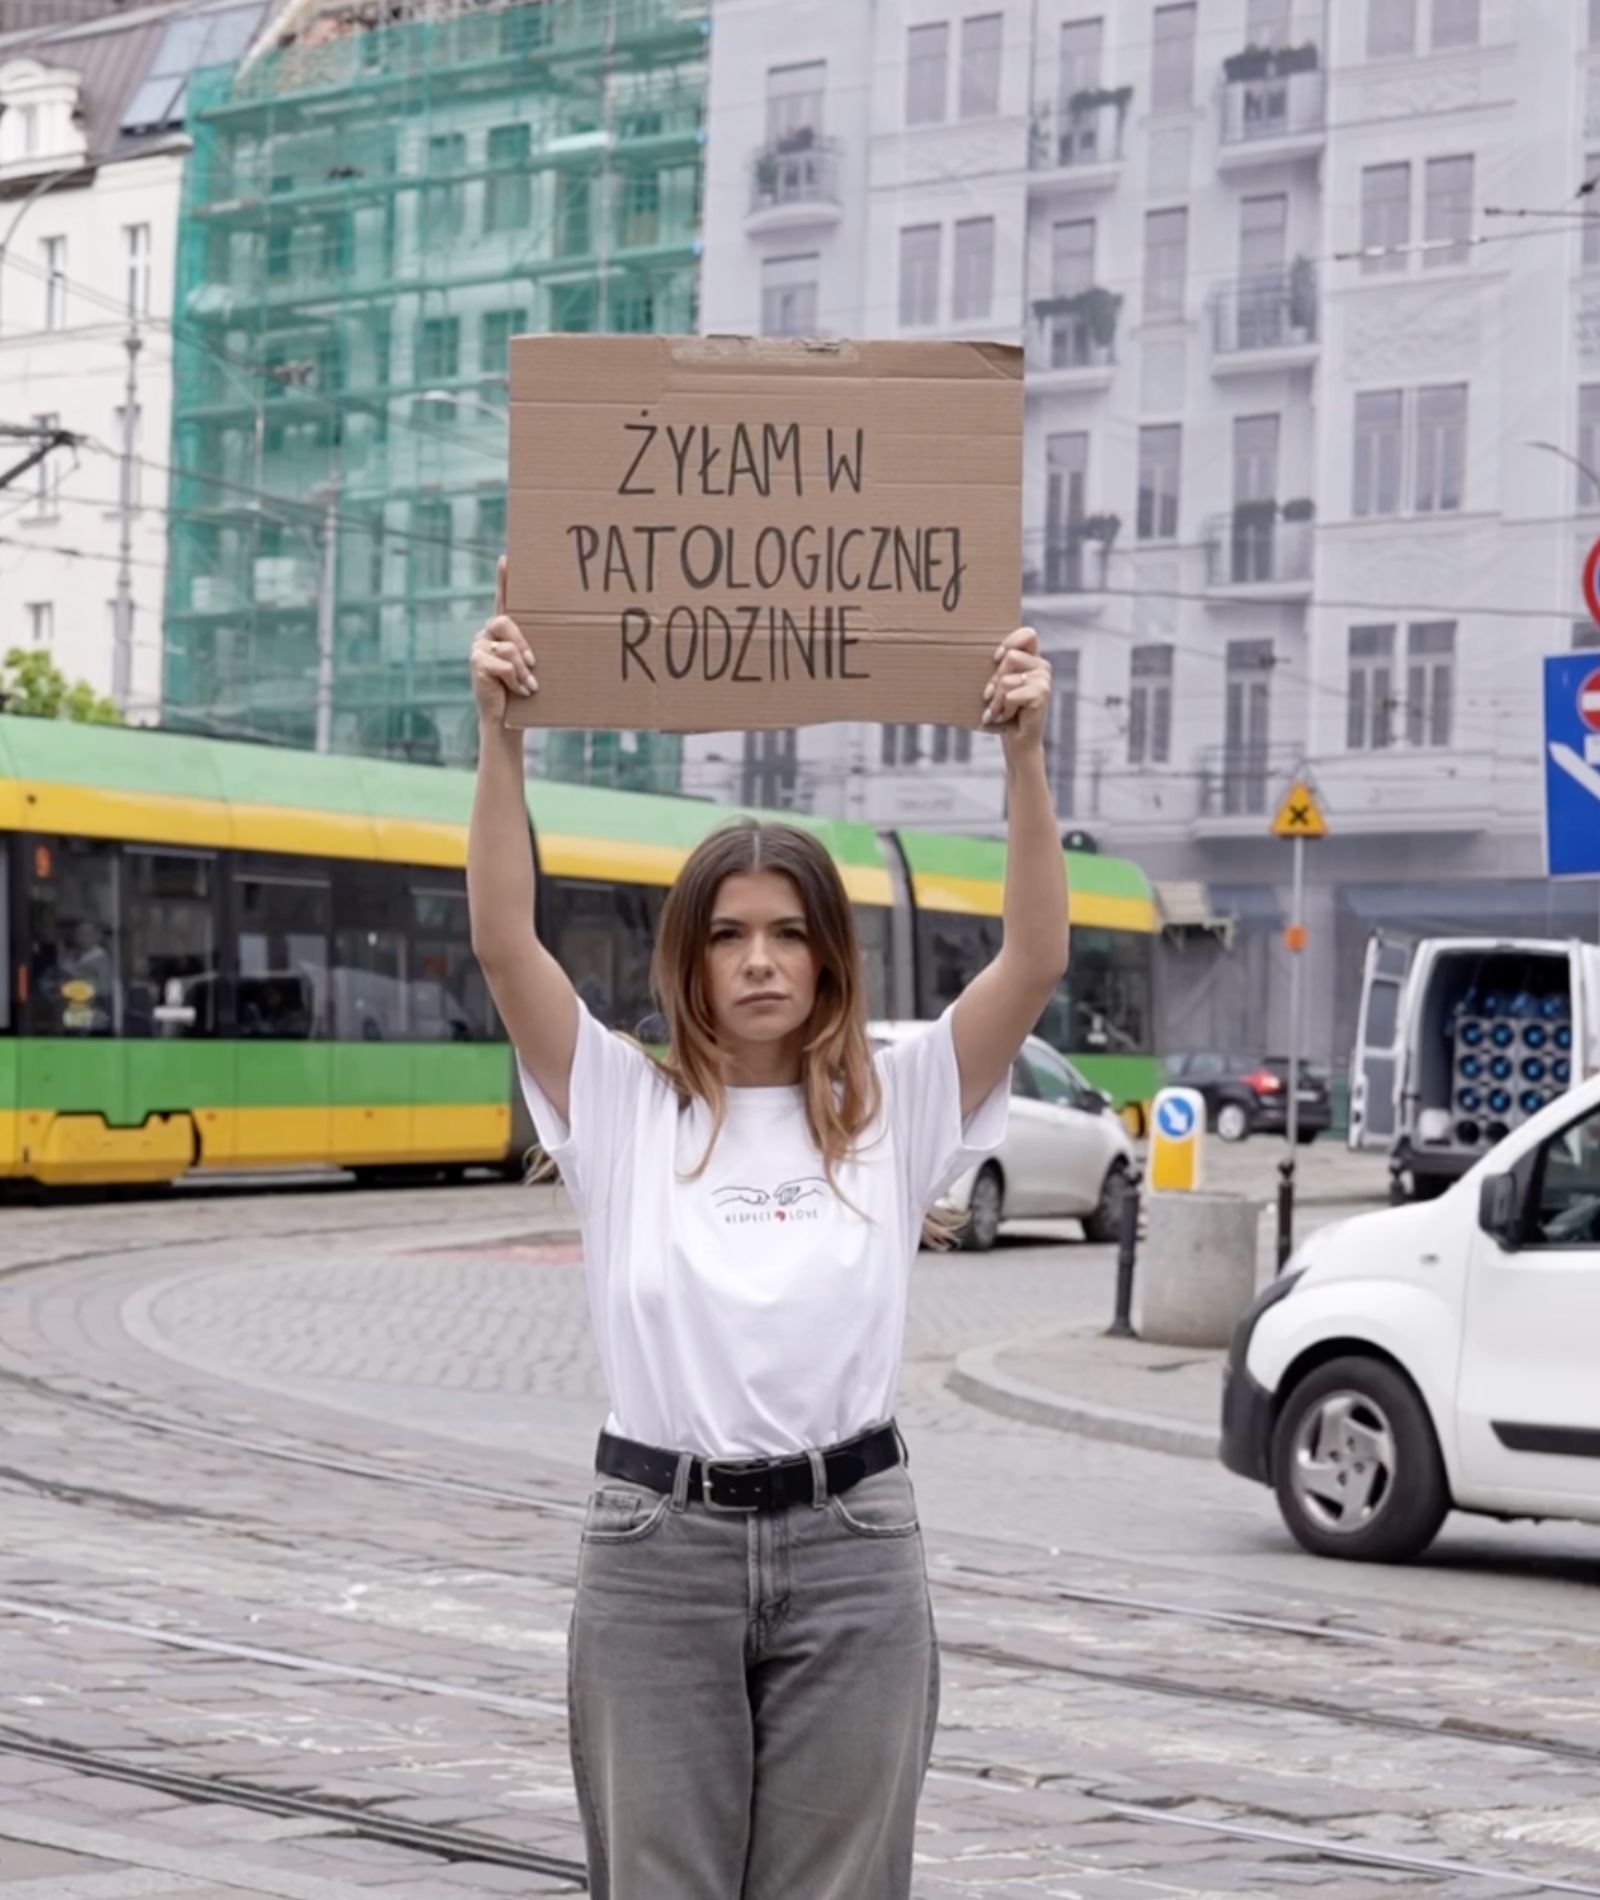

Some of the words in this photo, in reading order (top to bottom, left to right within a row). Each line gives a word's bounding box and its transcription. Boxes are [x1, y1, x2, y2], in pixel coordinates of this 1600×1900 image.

[618, 409, 803, 497] ŻYŁAM
[826, 427, 864, 493] W
[567, 524, 967, 612] PATOLOGICZNEJ
[620, 605, 870, 682] RODZINIE
[725, 1212, 771, 1224] RESPECT
[789, 1209, 818, 1220] LOVE
